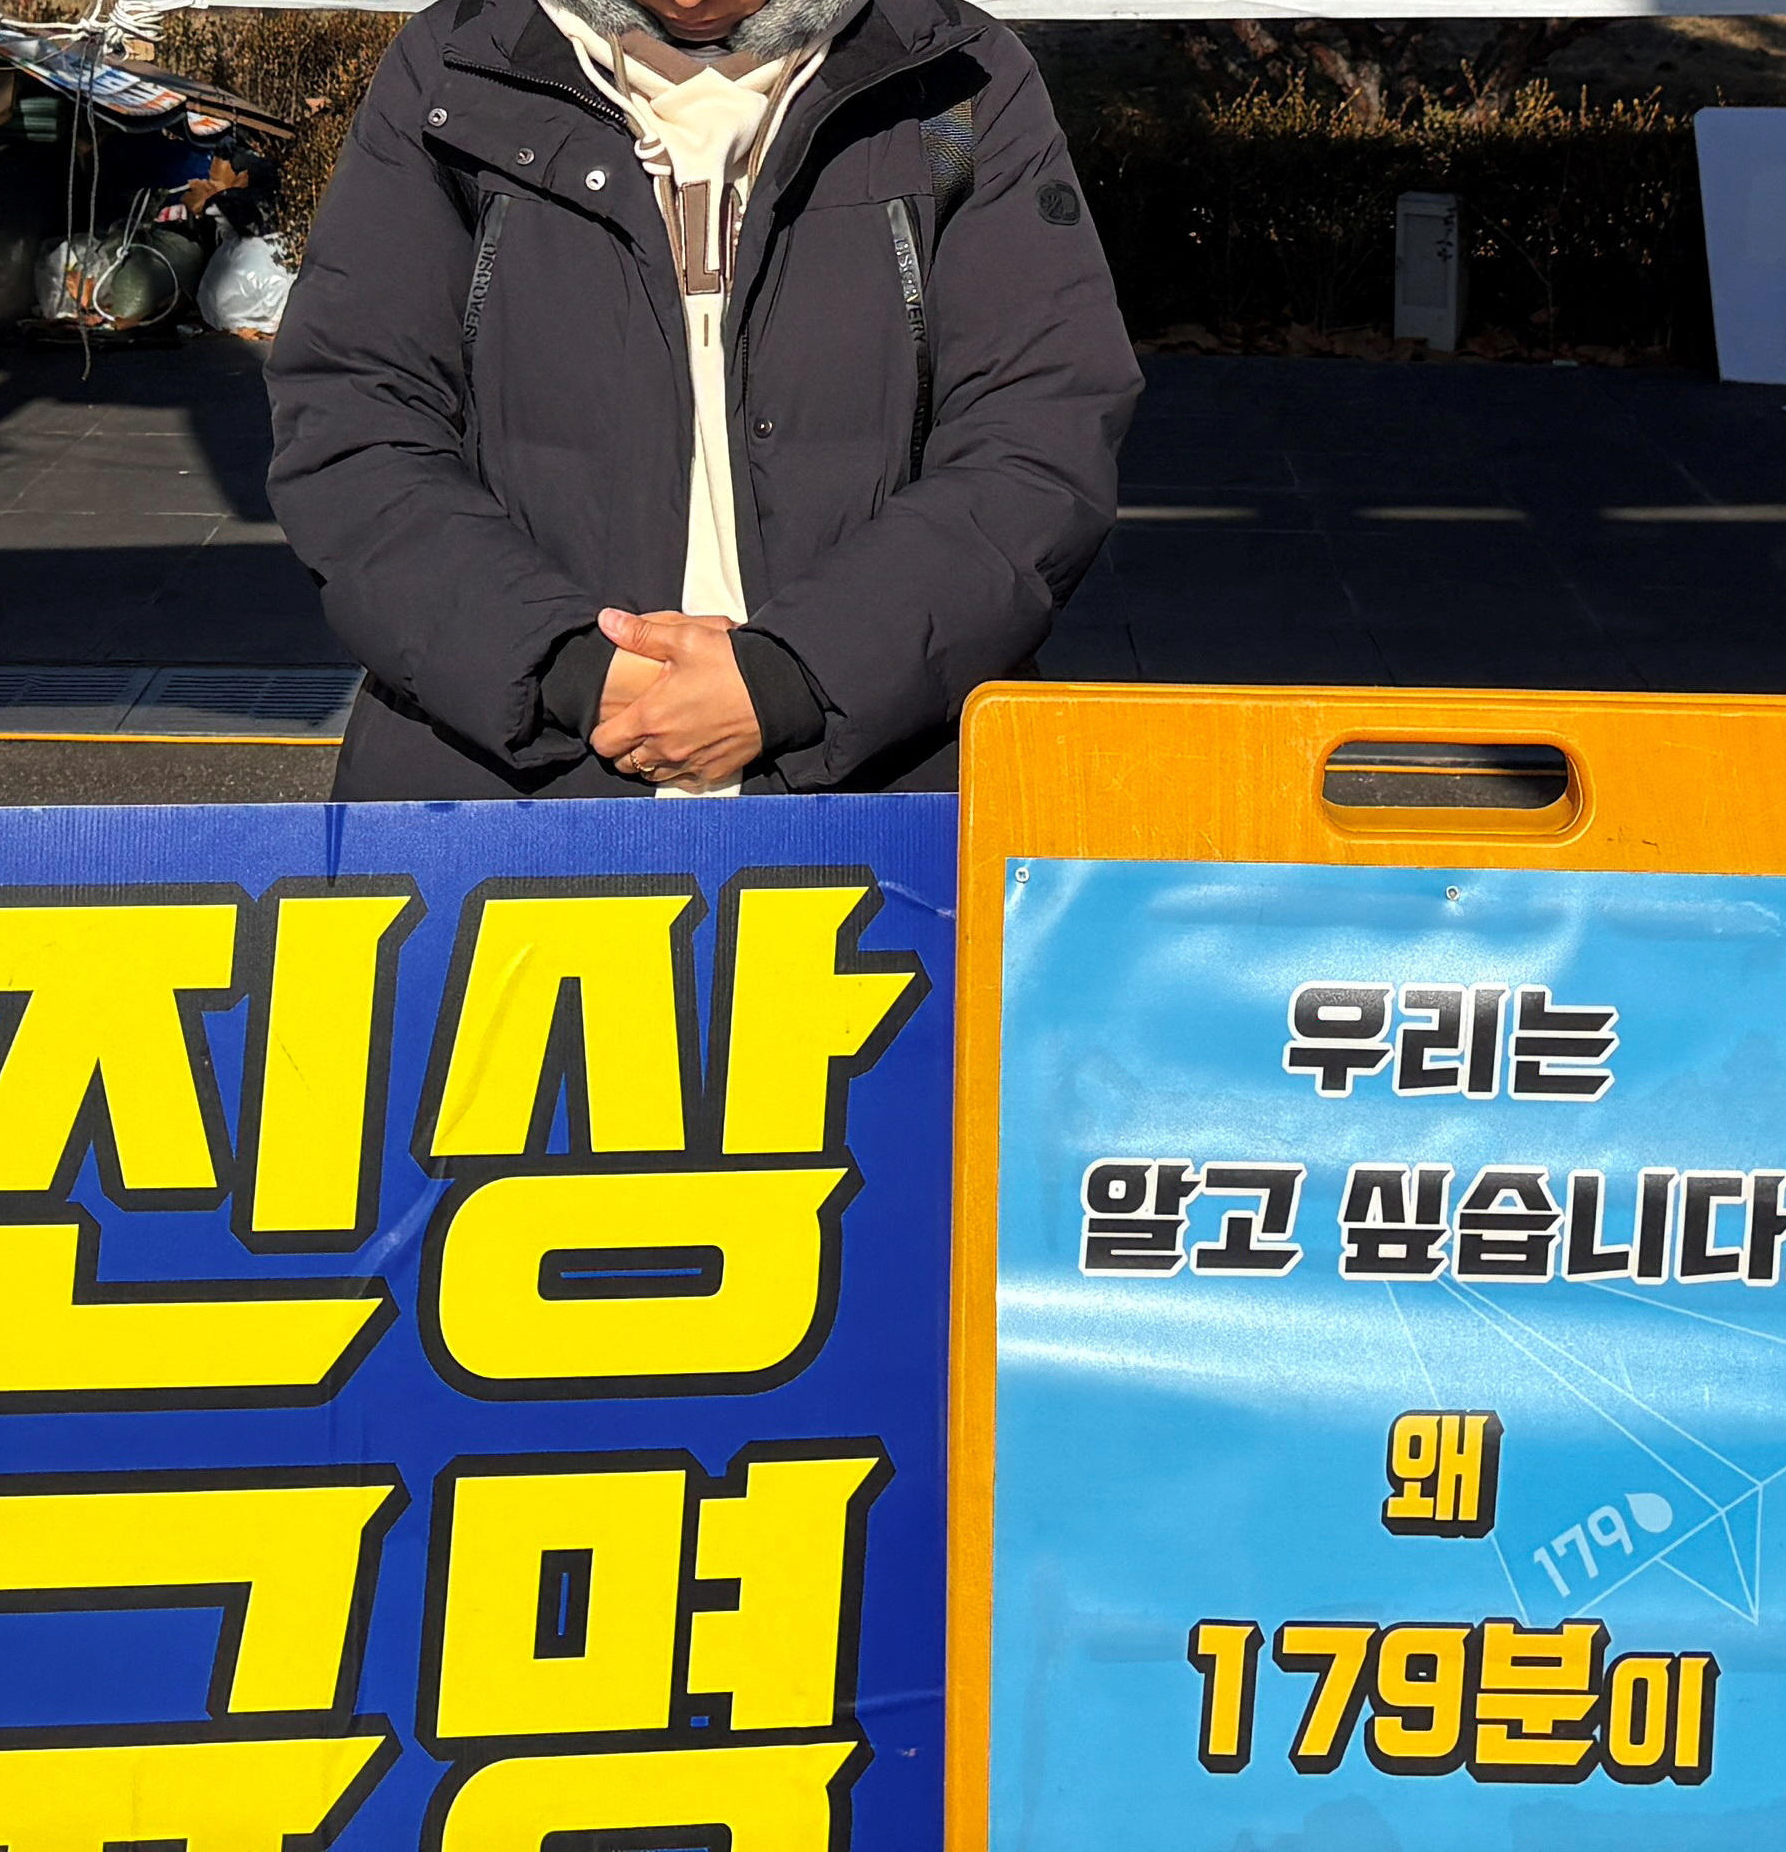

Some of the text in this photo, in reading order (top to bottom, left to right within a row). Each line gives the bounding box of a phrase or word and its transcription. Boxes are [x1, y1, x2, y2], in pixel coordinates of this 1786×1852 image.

[1284, 982, 1619, 1101] 우리는
[1082, 1159, 1305, 1278] 알고
[1382, 1410, 1503, 1536] 왜
[1190, 1620, 1720, 1786] 179분이
